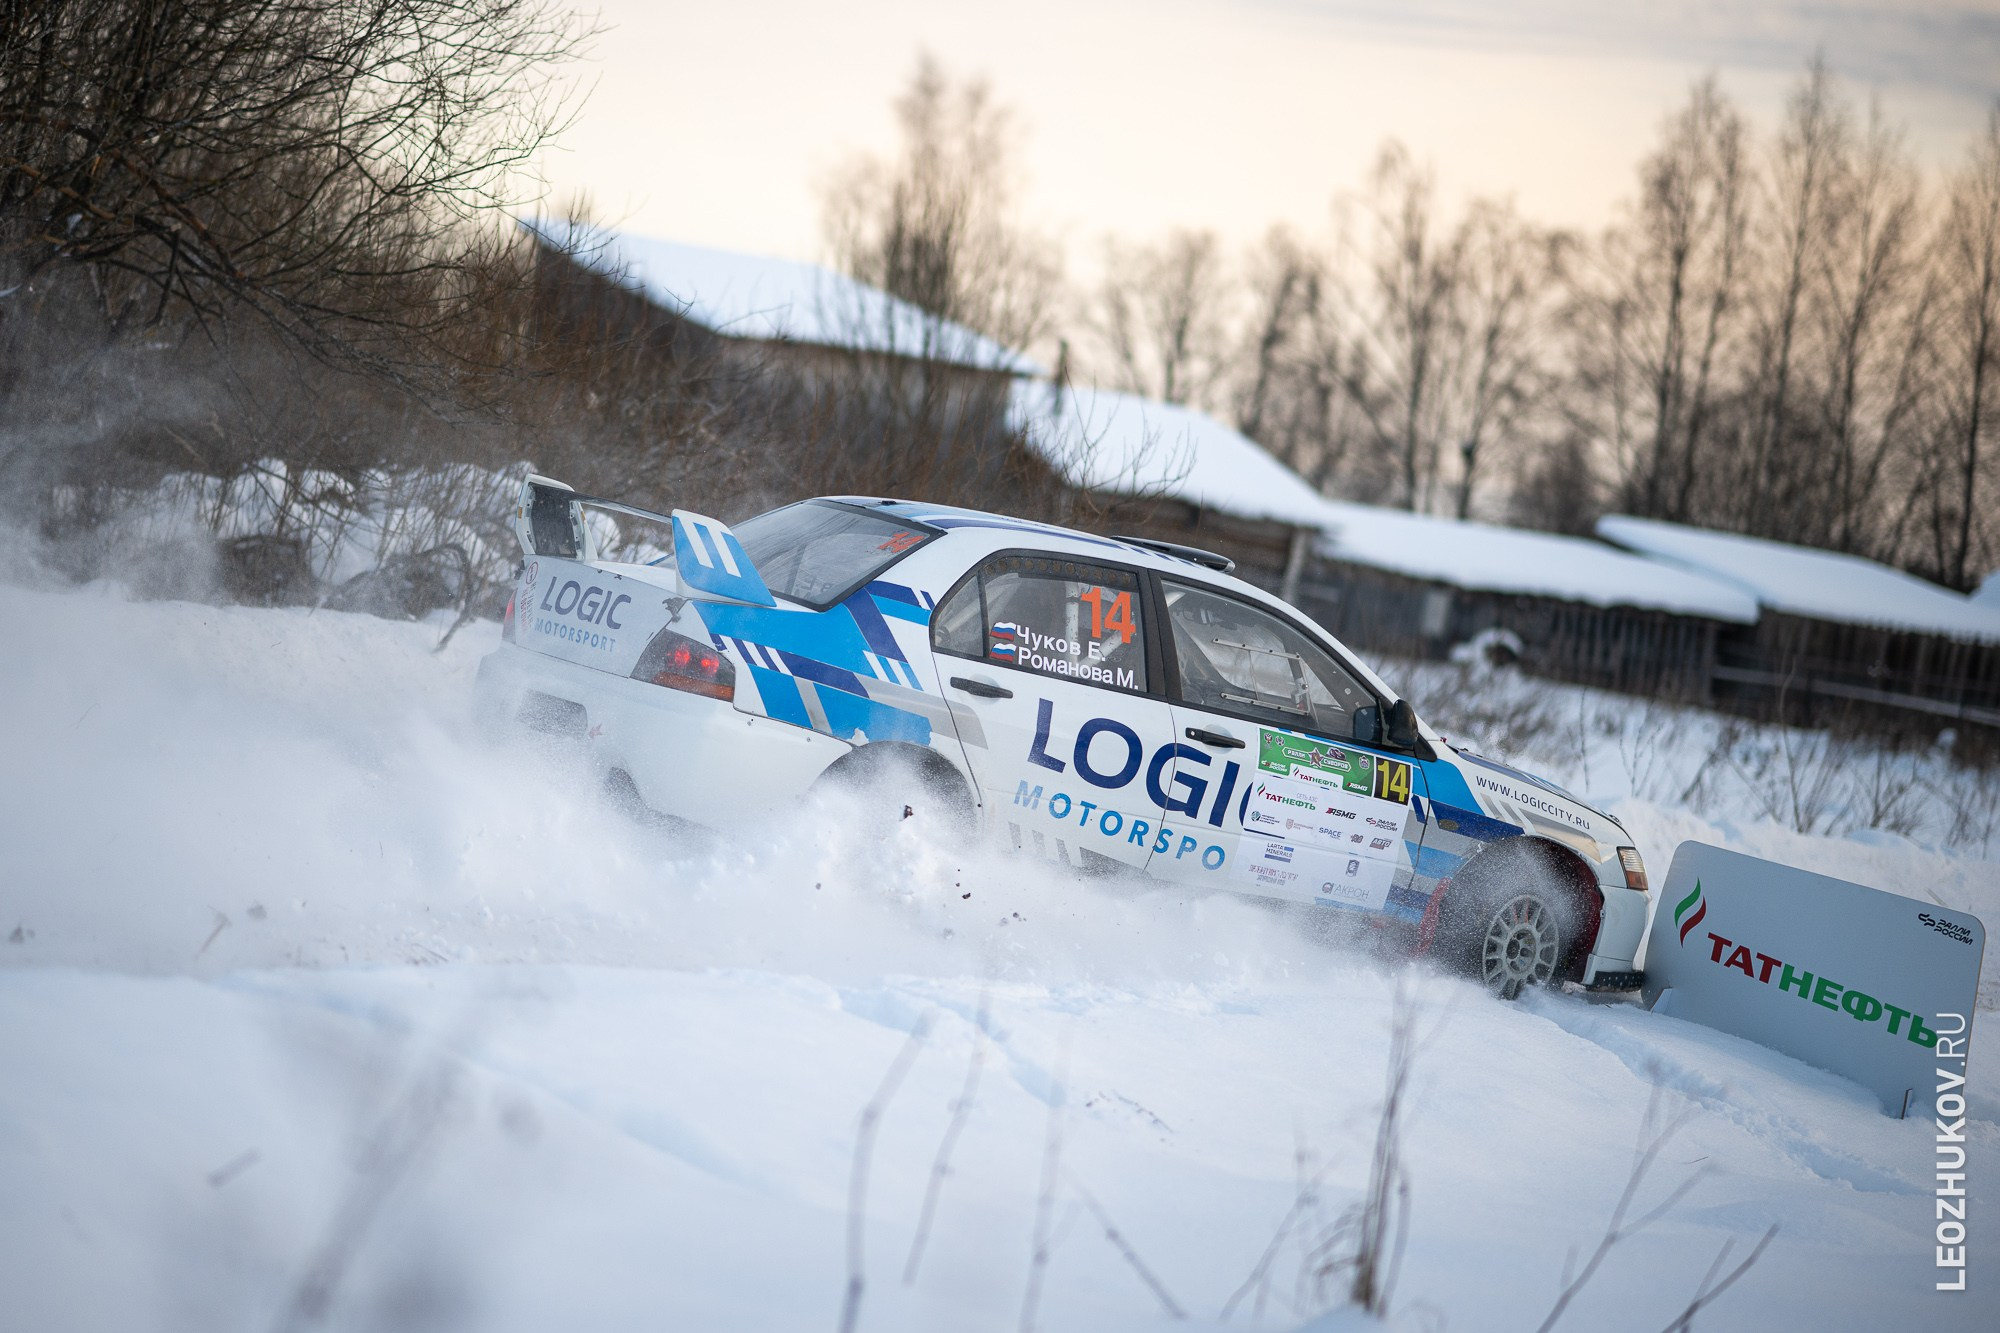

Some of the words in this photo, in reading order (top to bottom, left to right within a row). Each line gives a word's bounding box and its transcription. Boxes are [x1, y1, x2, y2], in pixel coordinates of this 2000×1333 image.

[877, 531, 925, 553] 14
[540, 576, 632, 630] LOGIC
[1081, 587, 1136, 644] 14
[534, 618, 616, 653] MOTORSPORT
[1016, 625, 1081, 657] Чуков
[1088, 641, 1106, 662] Е.
[1018, 646, 1114, 685] Романова
[1116, 667, 1139, 690] М.
[1027, 698, 1253, 828] LOGI
[1300, 773, 1338, 788] ТАТНЕФТЬ
[1378, 760, 1408, 803] 14
[1265, 792, 1316, 811] ТАТНЕФТЬ
[1476, 775, 1590, 830] WWW.LOGICCITY.RU
[1318, 827, 1342, 838] SPACE
[1334, 885, 1370, 899] АКРОН
[1934, 925, 1974, 946] РОССИИ
[1937, 919, 1971, 937] РАЛЛИ
[1707, 932, 1939, 1049] ТАТНЕФТЬ
